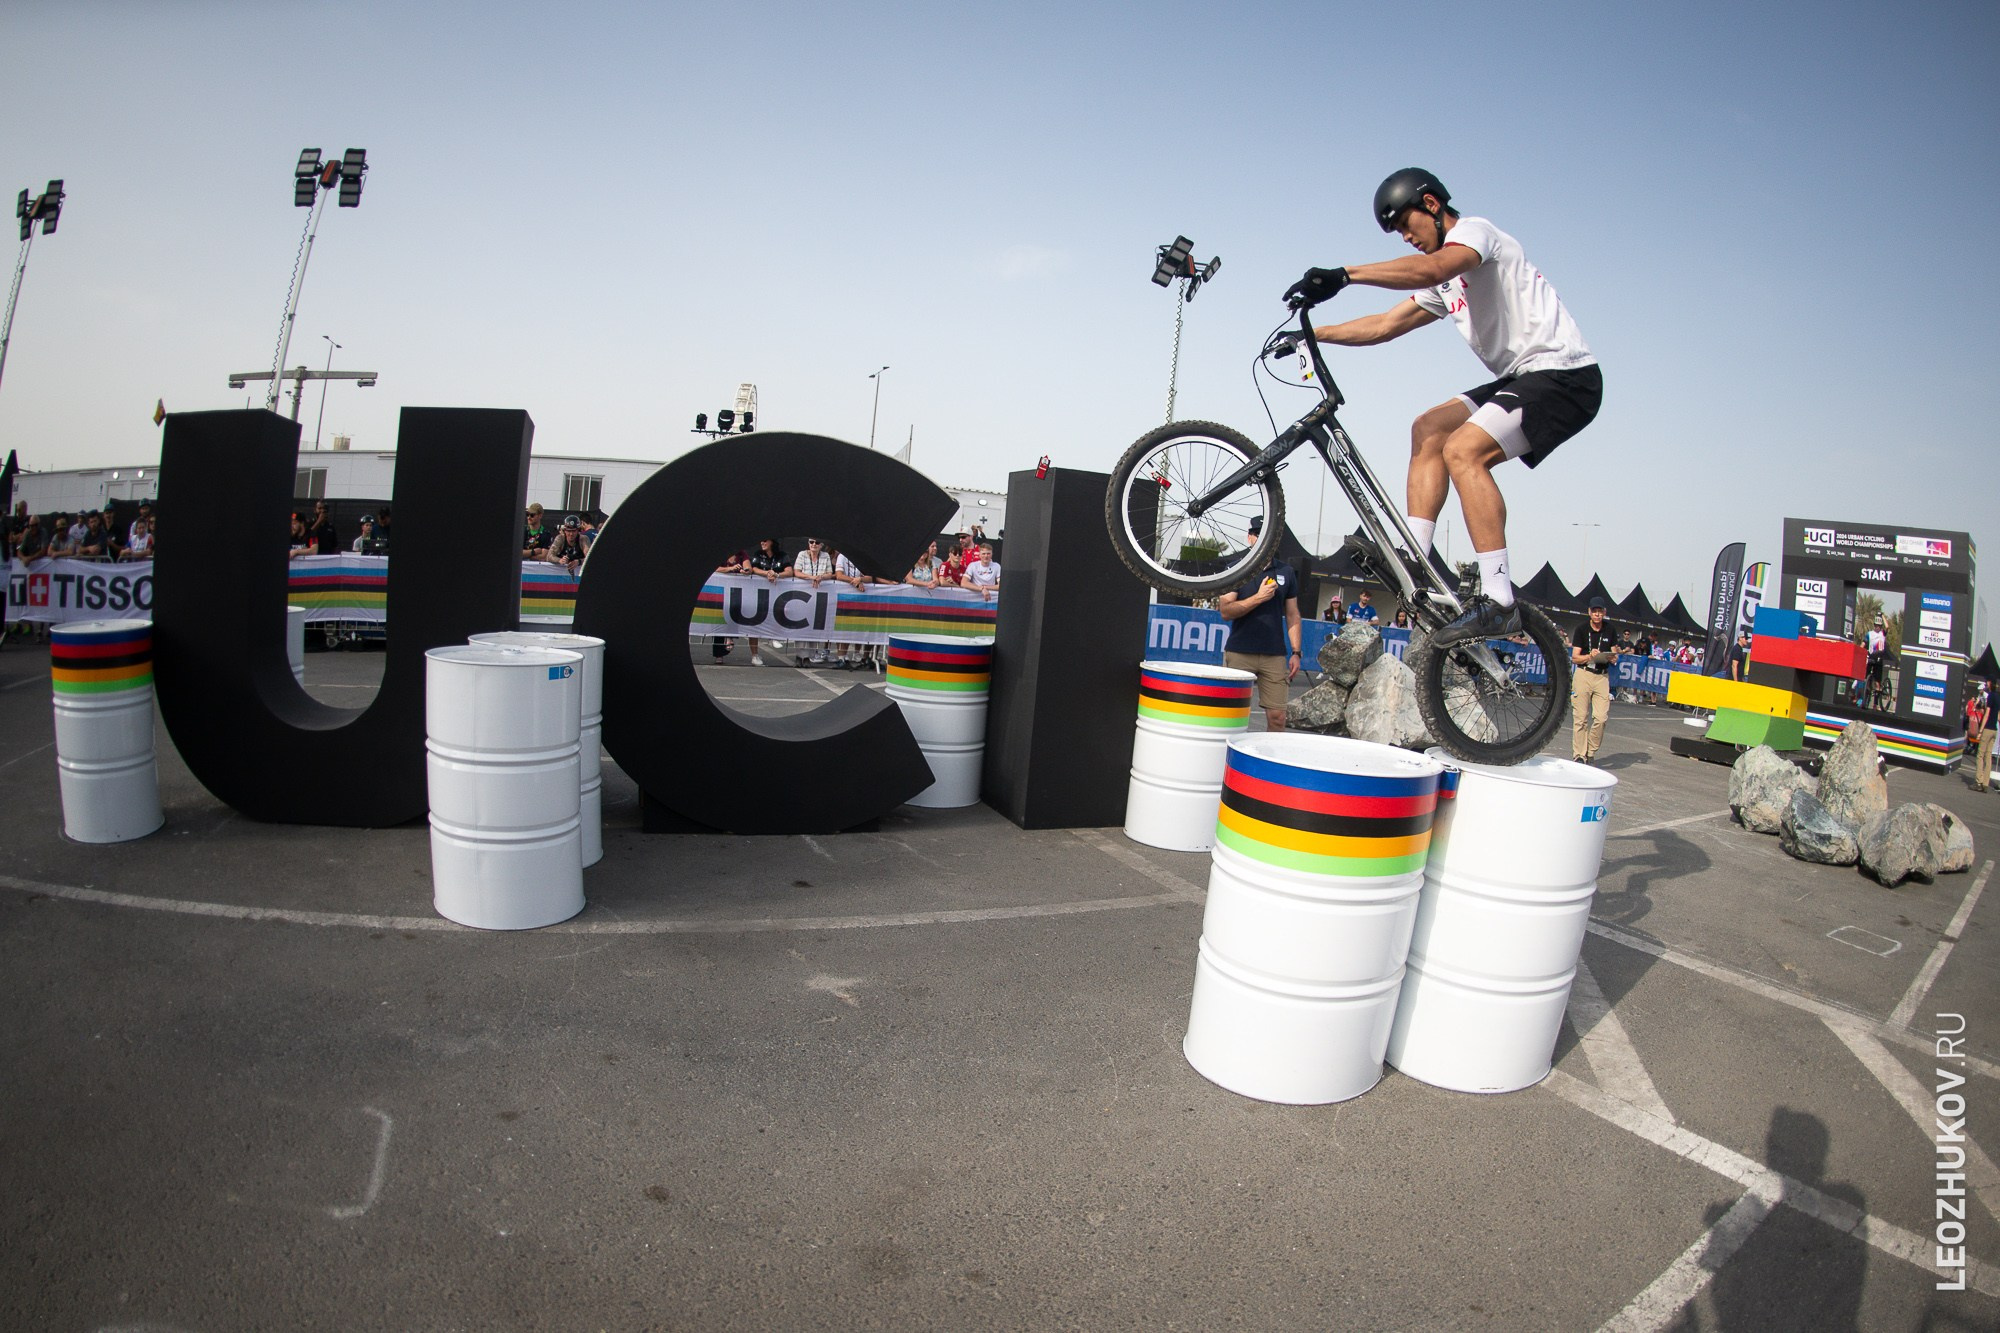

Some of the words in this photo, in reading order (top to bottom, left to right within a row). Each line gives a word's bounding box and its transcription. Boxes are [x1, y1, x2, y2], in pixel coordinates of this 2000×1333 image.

[1809, 532, 1832, 544] UCI
[1864, 535, 1884, 543] CYCLING
[1853, 540, 1893, 550] CHAMPIONSHIPS
[1861, 568, 1892, 582] START
[53, 574, 153, 611] TISSO
[1803, 582, 1823, 593] UCI
[1923, 597, 1951, 607] SHIMANO
[728, 587, 828, 630] UCI
[152, 406, 1159, 834] UCI
[1714, 608, 1724, 630] Abu
[1924, 636, 1945, 644] TISSOT
[1927, 650, 1939, 658] UCI
[1916, 683, 1944, 693] SHIMANO
